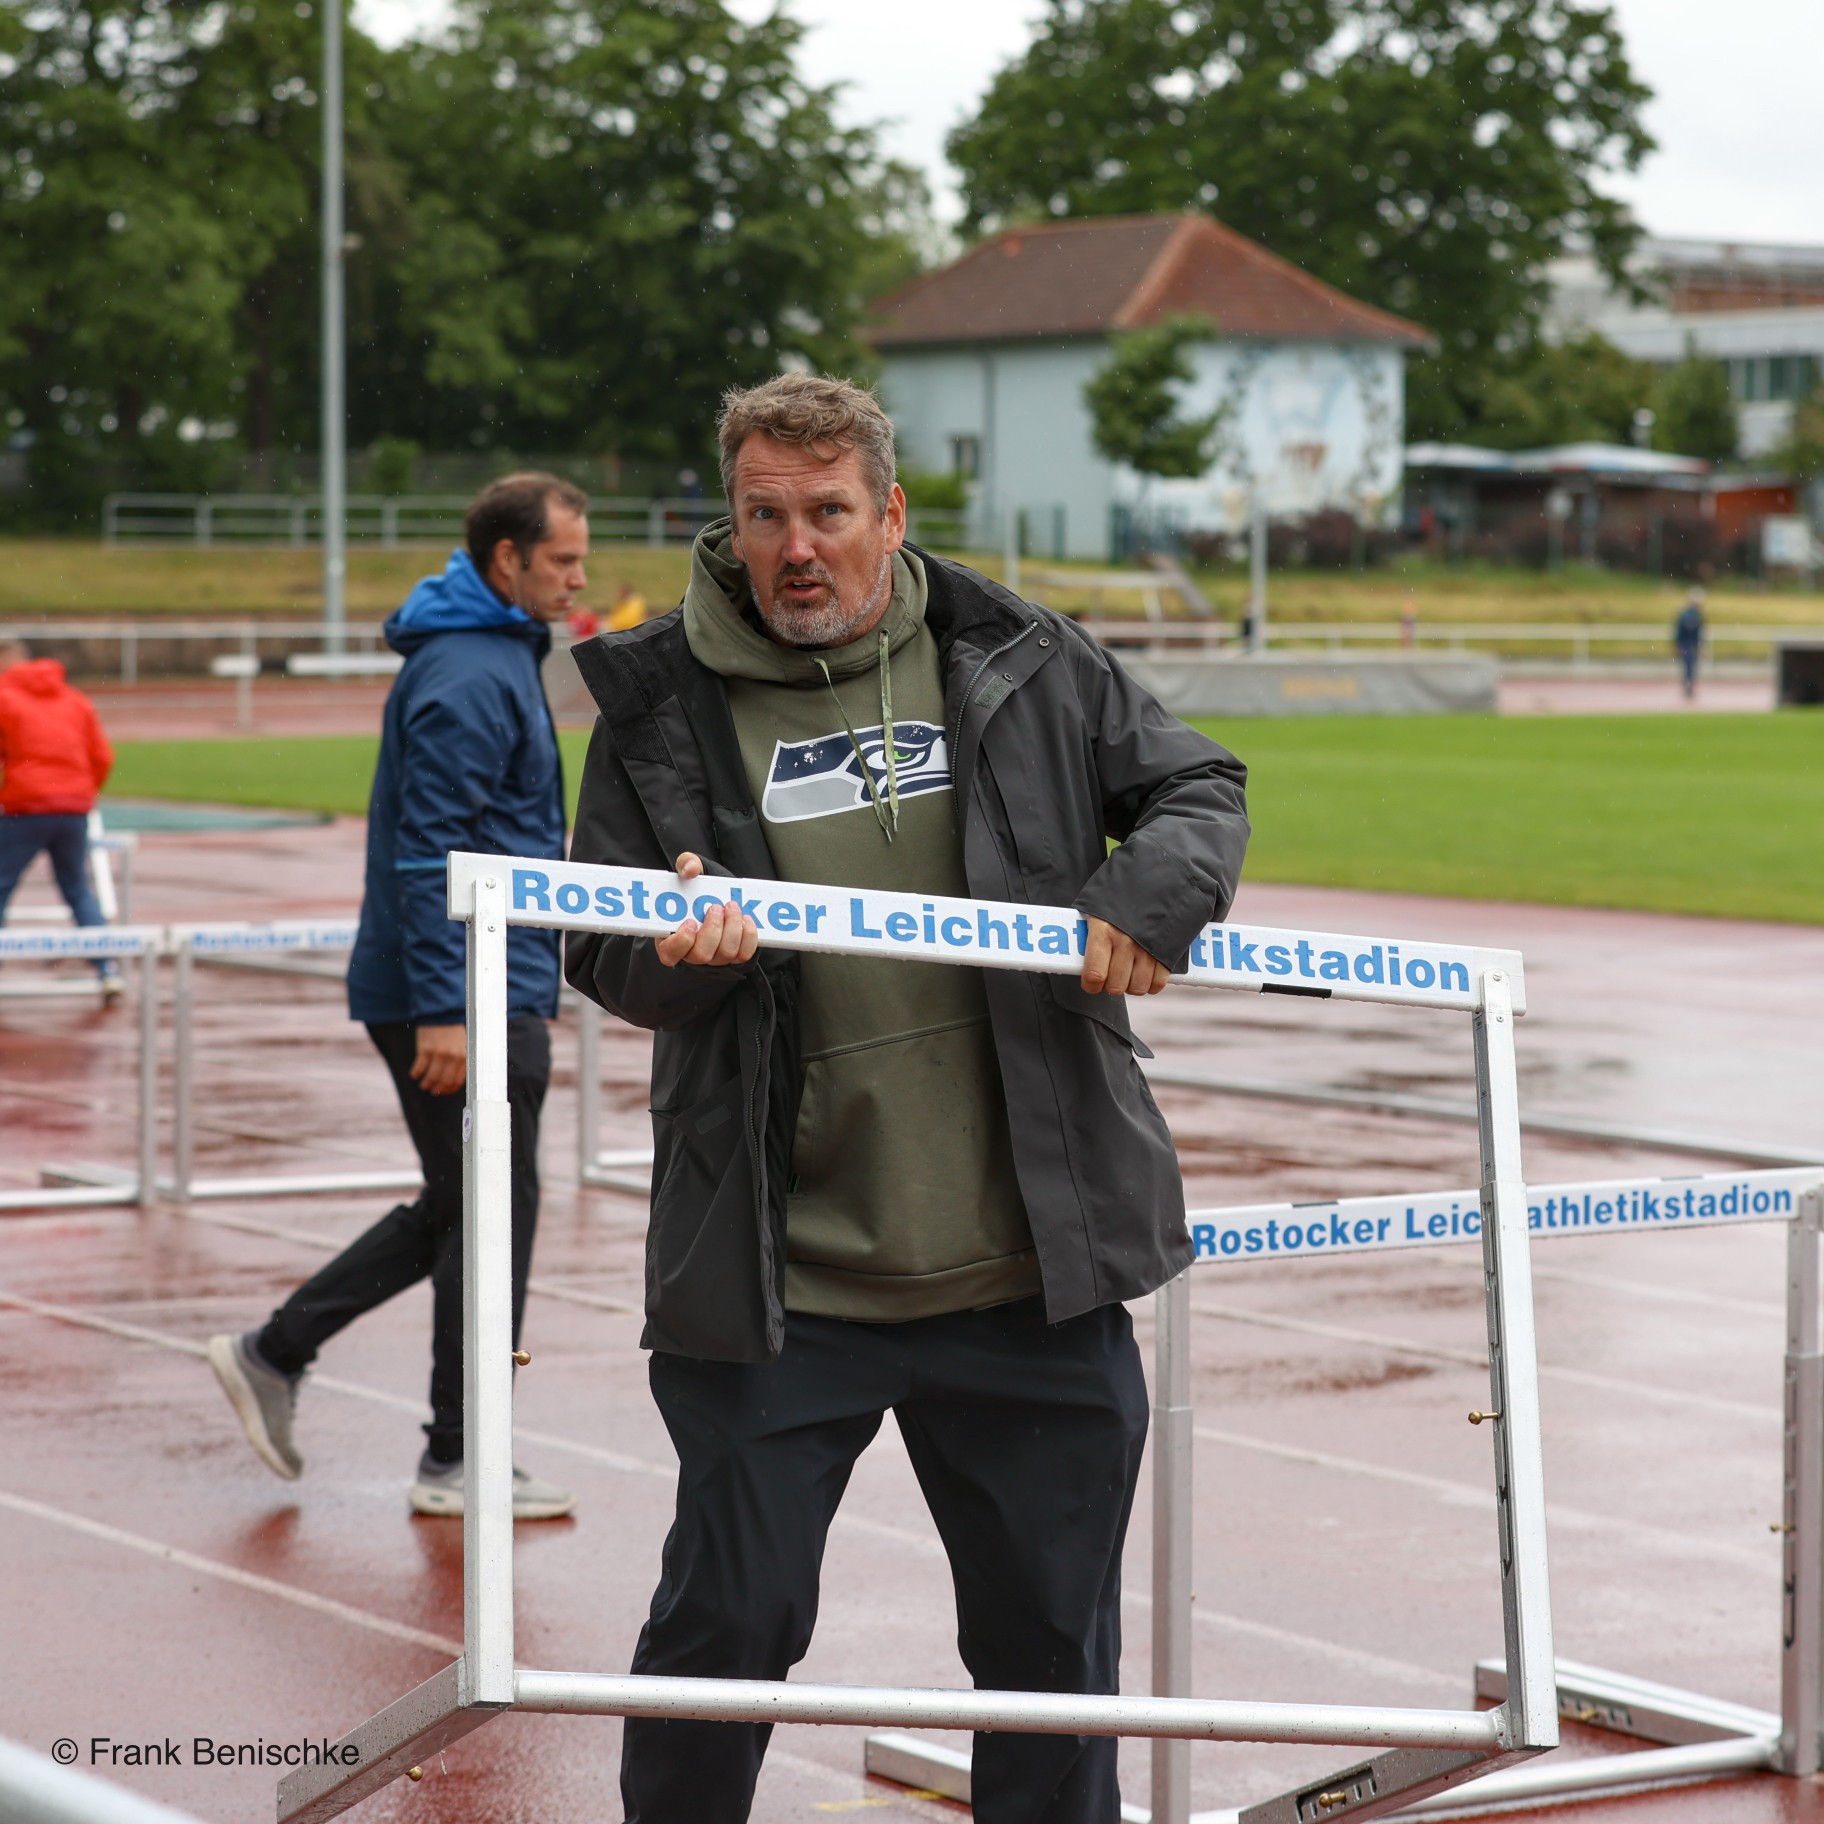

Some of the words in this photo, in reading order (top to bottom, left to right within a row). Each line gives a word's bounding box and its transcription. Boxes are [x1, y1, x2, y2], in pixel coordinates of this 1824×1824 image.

[849, 897, 1471, 993] Leichtattikstadion
[1192, 1213, 1391, 1257] Rostocker
[1405, 1184, 1792, 1240] Leicathletikstadion
